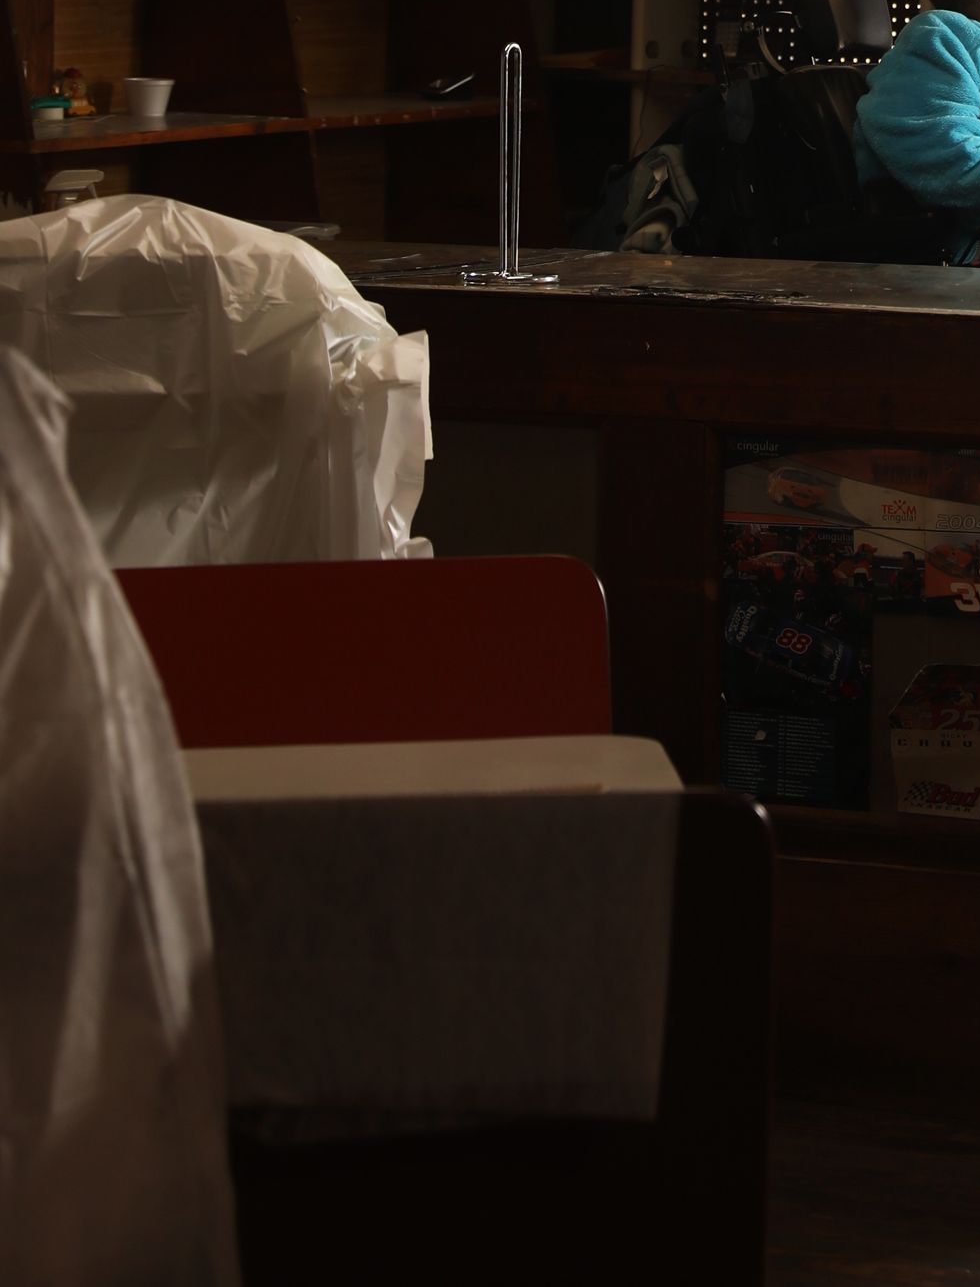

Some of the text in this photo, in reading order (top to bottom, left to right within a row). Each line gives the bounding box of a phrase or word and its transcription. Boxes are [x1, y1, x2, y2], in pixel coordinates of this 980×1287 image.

[736, 440, 781, 454] cingular
[776, 627, 813, 655] 88
[940, 708, 980, 731] 25
